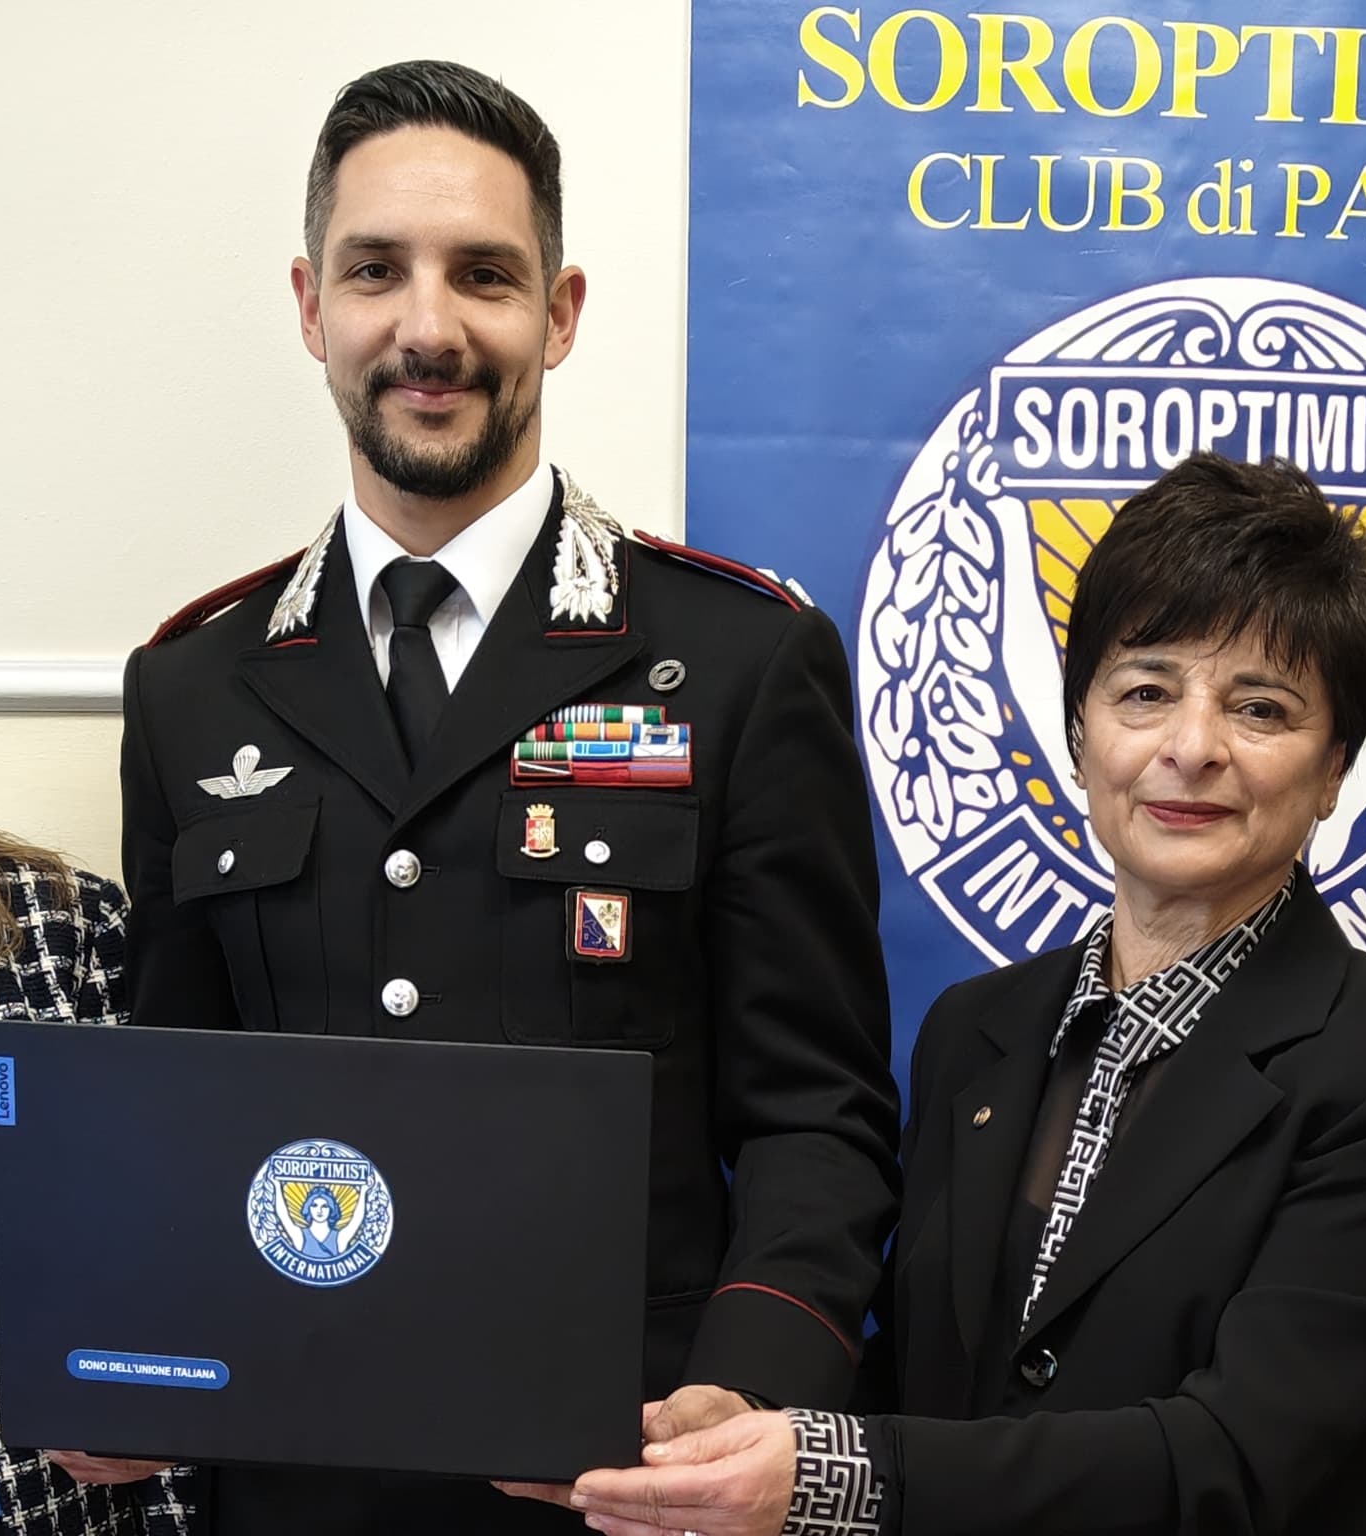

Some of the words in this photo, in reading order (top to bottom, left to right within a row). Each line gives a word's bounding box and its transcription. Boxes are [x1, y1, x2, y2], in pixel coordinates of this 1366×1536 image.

[907, 152, 1164, 233] CLUB
[1187, 159, 1255, 235] di
[274, 1159, 368, 1180] SOROPTIMIST
[268, 1242, 372, 1280] INTERNATIONAL
[78, 1359, 108, 1371] DONO
[109, 1362, 172, 1376] DELL'UNIONE
[173, 1367, 217, 1380] ITALIANA
